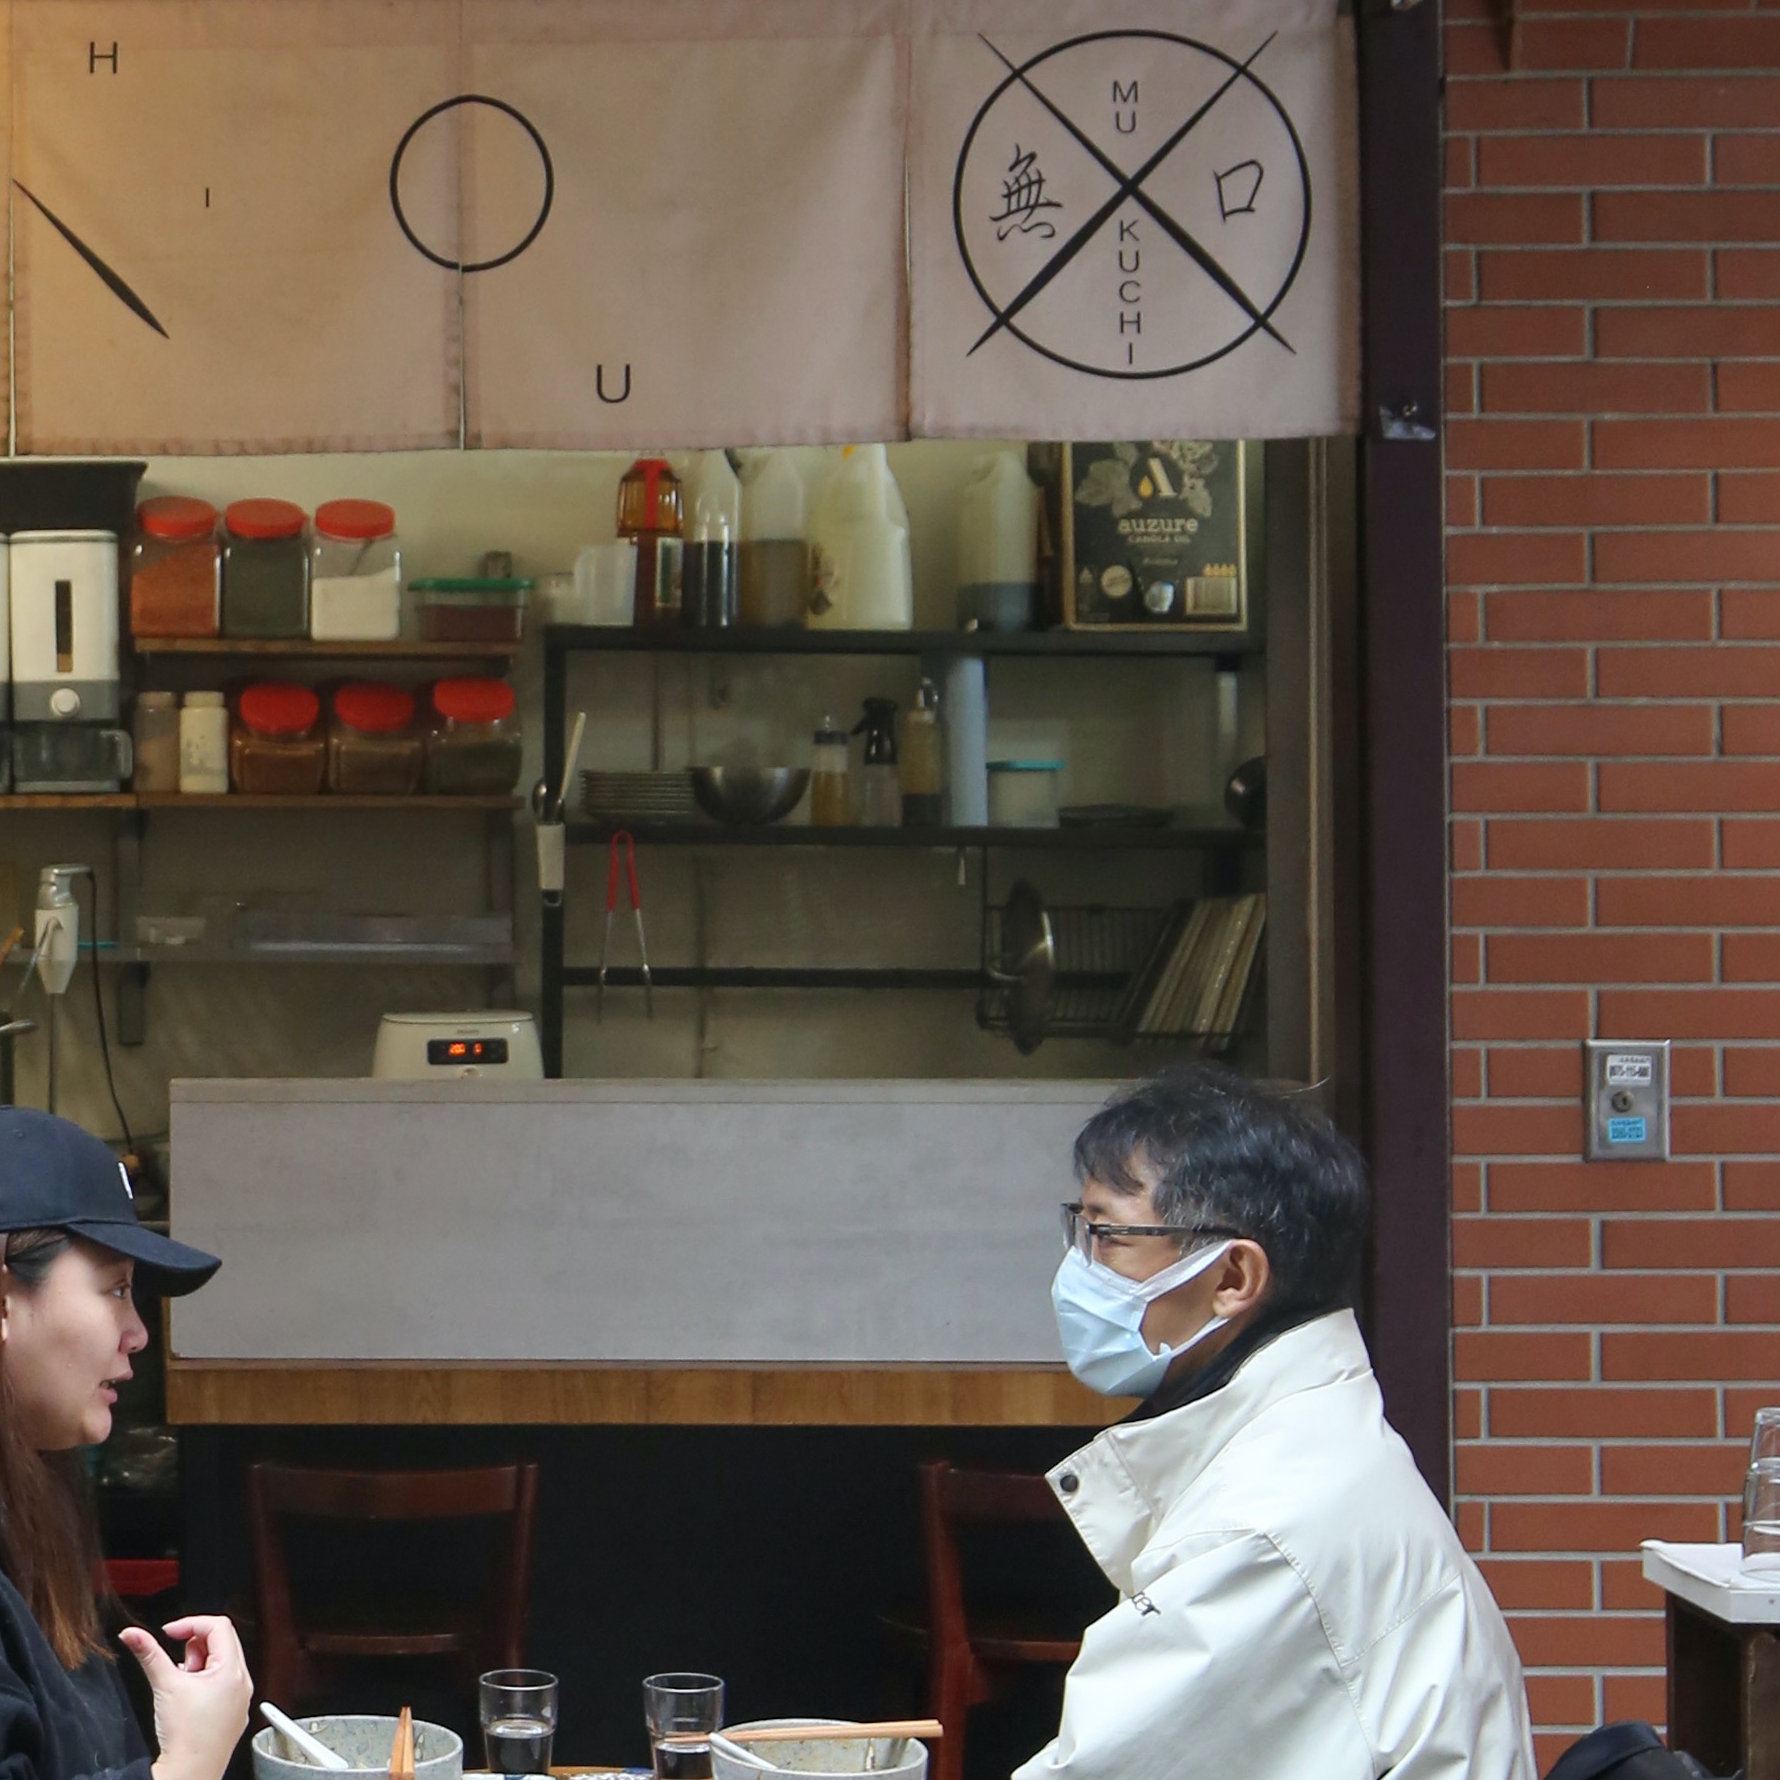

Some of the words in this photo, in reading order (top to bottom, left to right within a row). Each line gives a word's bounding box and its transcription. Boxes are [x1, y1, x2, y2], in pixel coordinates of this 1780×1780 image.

[88, 41, 118, 75] H
[989, 143, 1064, 242] 無
[1213, 159, 1264, 224] 口
[595, 363, 632, 404] U
[1117, 518, 1199, 534] auzure
